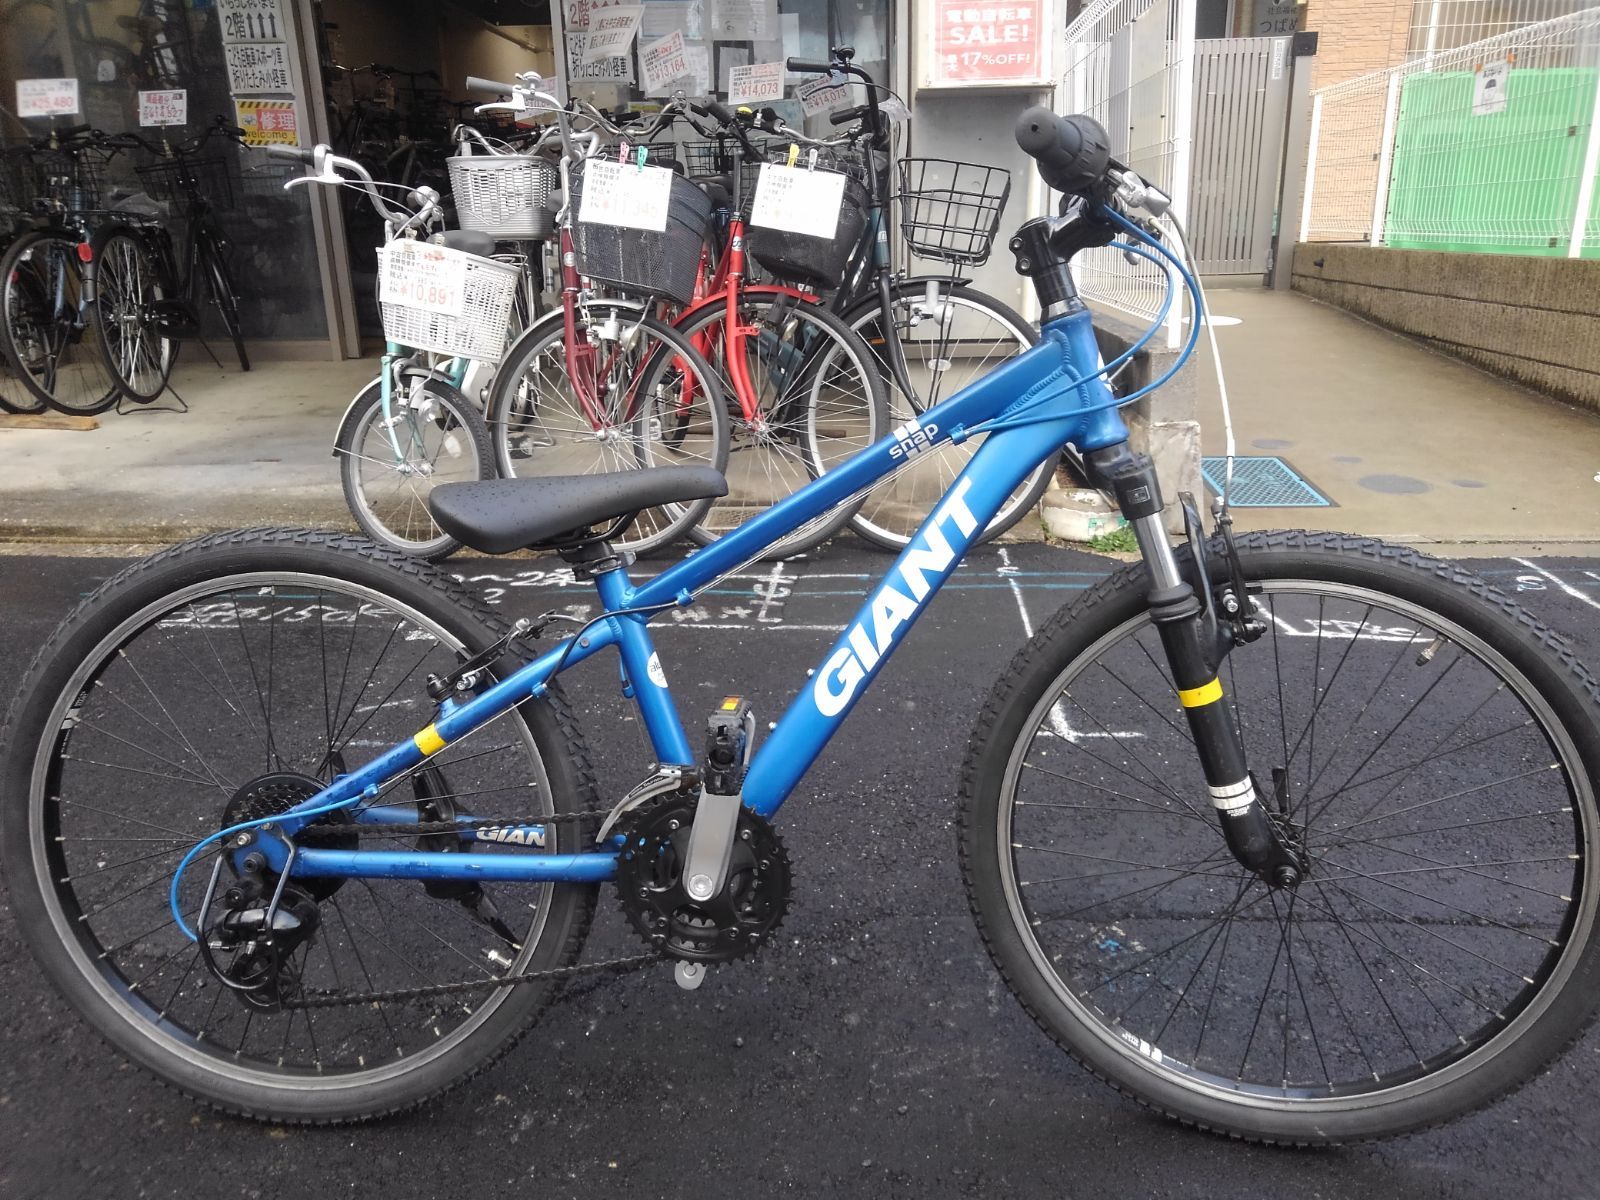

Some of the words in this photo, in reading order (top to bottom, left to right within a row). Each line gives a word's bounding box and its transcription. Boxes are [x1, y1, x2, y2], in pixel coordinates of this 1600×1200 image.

[225, 12, 246, 39] 2階
[949, 24, 1029, 45] SALE!
[961, 51, 1031, 66] 17%OFF!
[740, 82, 778, 97] ¥14,073
[889, 423, 939, 460] snap
[814, 476, 979, 717] GIANT
